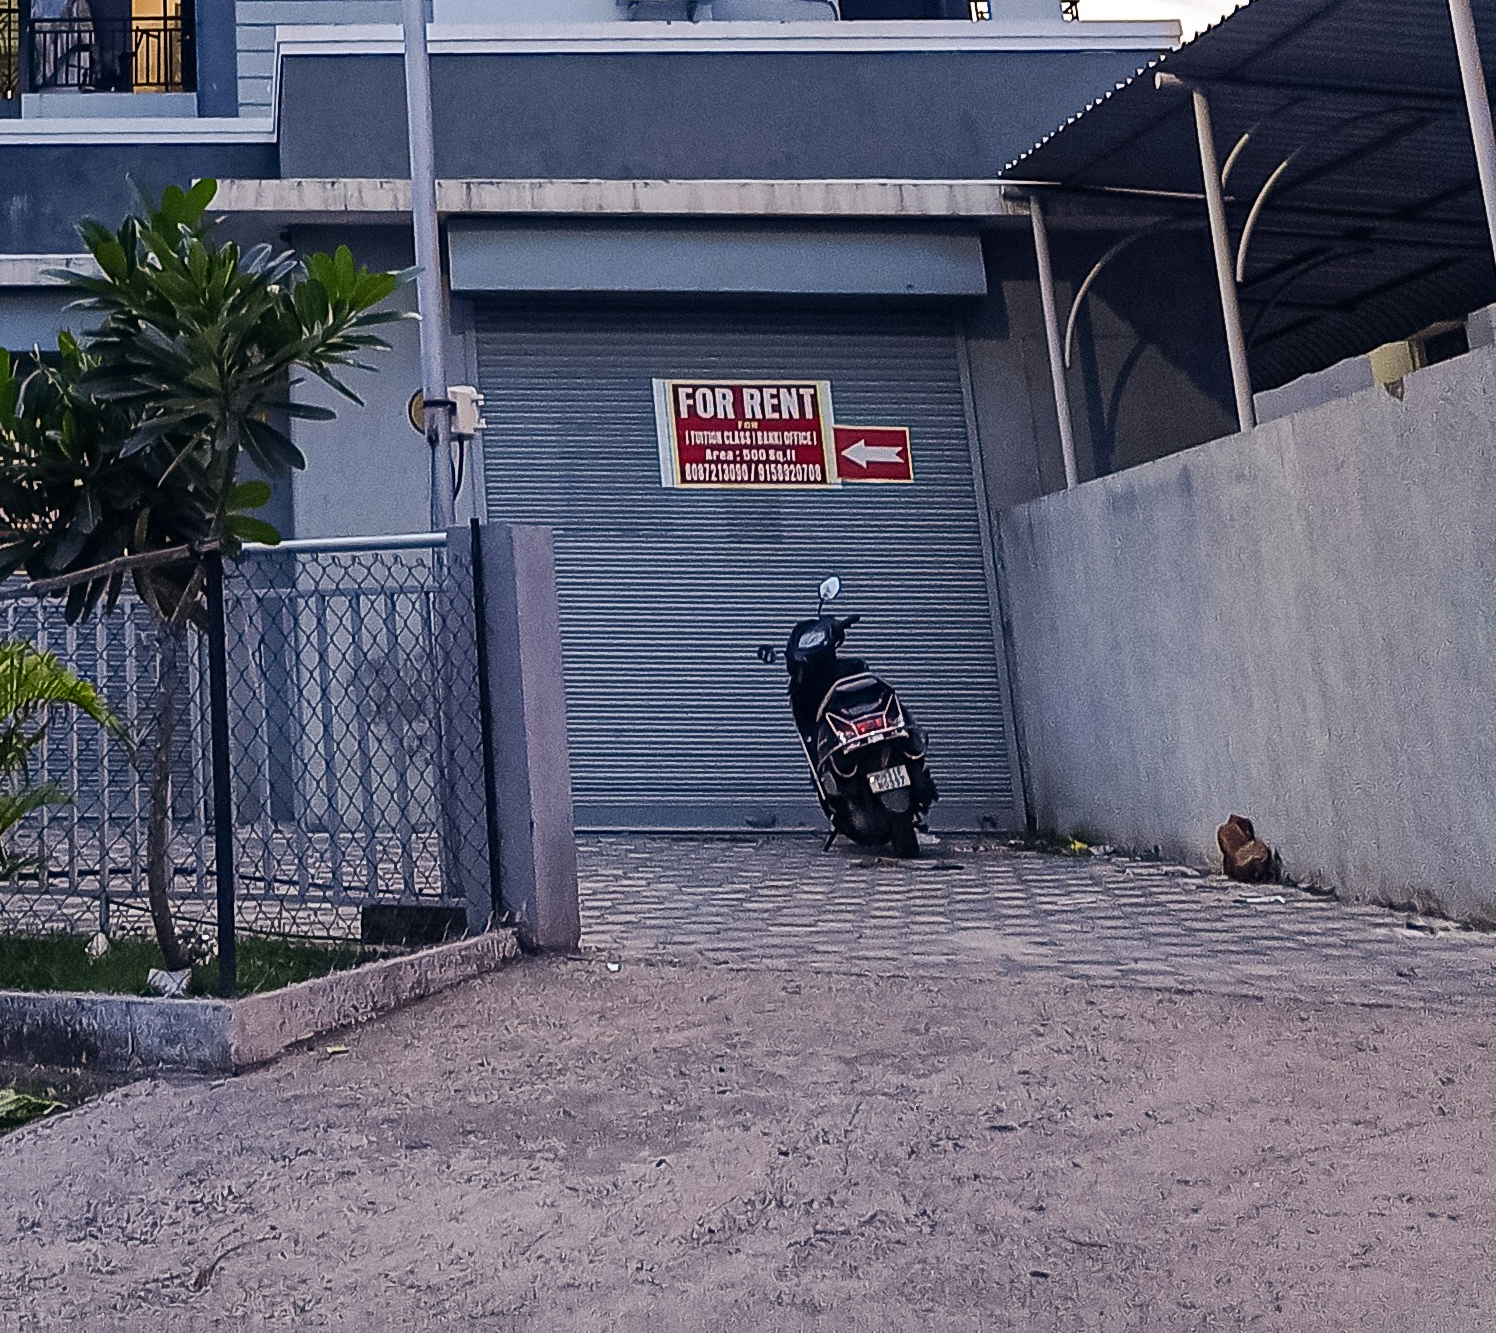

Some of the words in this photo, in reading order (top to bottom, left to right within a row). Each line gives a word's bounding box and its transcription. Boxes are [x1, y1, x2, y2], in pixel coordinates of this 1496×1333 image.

[678, 388, 735, 419] FOR
[742, 388, 815, 420] RENT
[690, 430, 723, 446] TUITION
[724, 430, 752, 446] CLASS
[784, 430, 812, 446] OFFICE
[705, 448, 734, 461] Area
[742, 448, 767, 461] 500
